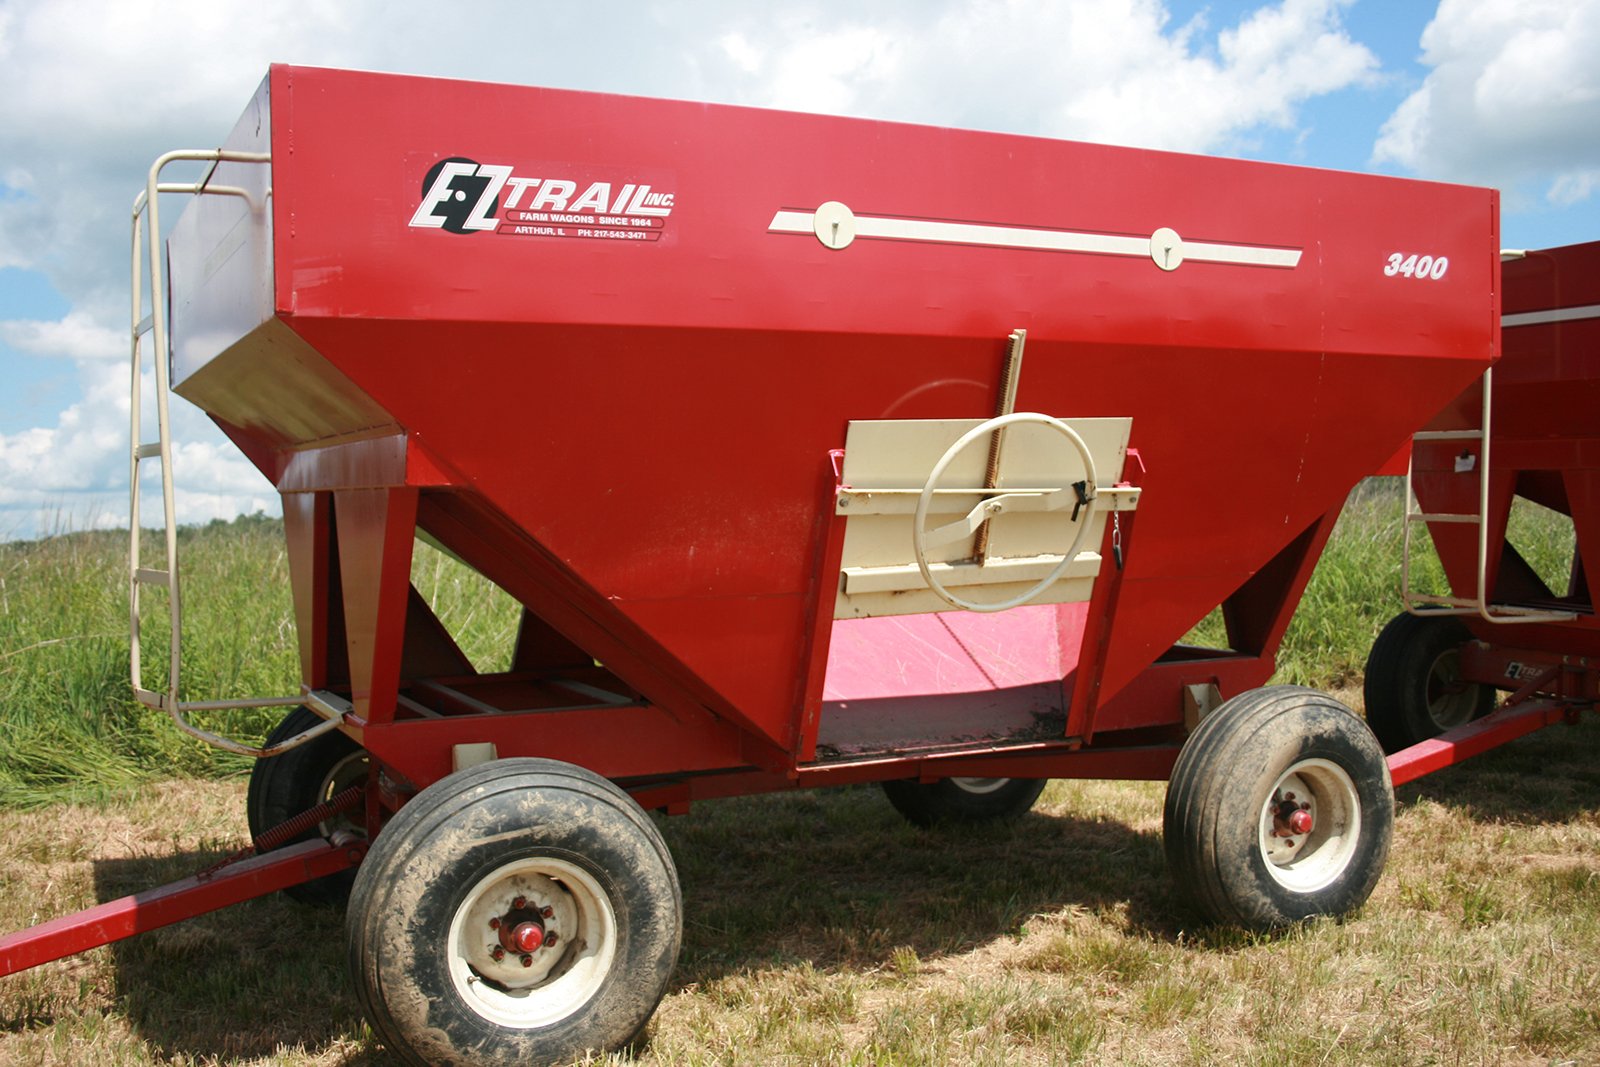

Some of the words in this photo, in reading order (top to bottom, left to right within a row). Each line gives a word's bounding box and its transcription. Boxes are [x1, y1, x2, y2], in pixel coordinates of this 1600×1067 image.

[504, 177, 672, 216] TRAIL
[644, 192, 675, 207] INC.
[519, 212, 549, 222] FARM
[551, 213, 595, 225] WAGONS
[599, 216, 628, 226] SINCE
[631, 218, 652, 227] 1964
[558, 228, 566, 236] IL
[577, 229, 593, 238] PH:
[594, 230, 647, 239] 217-543-3471
[1384, 252, 1448, 280] 3400
